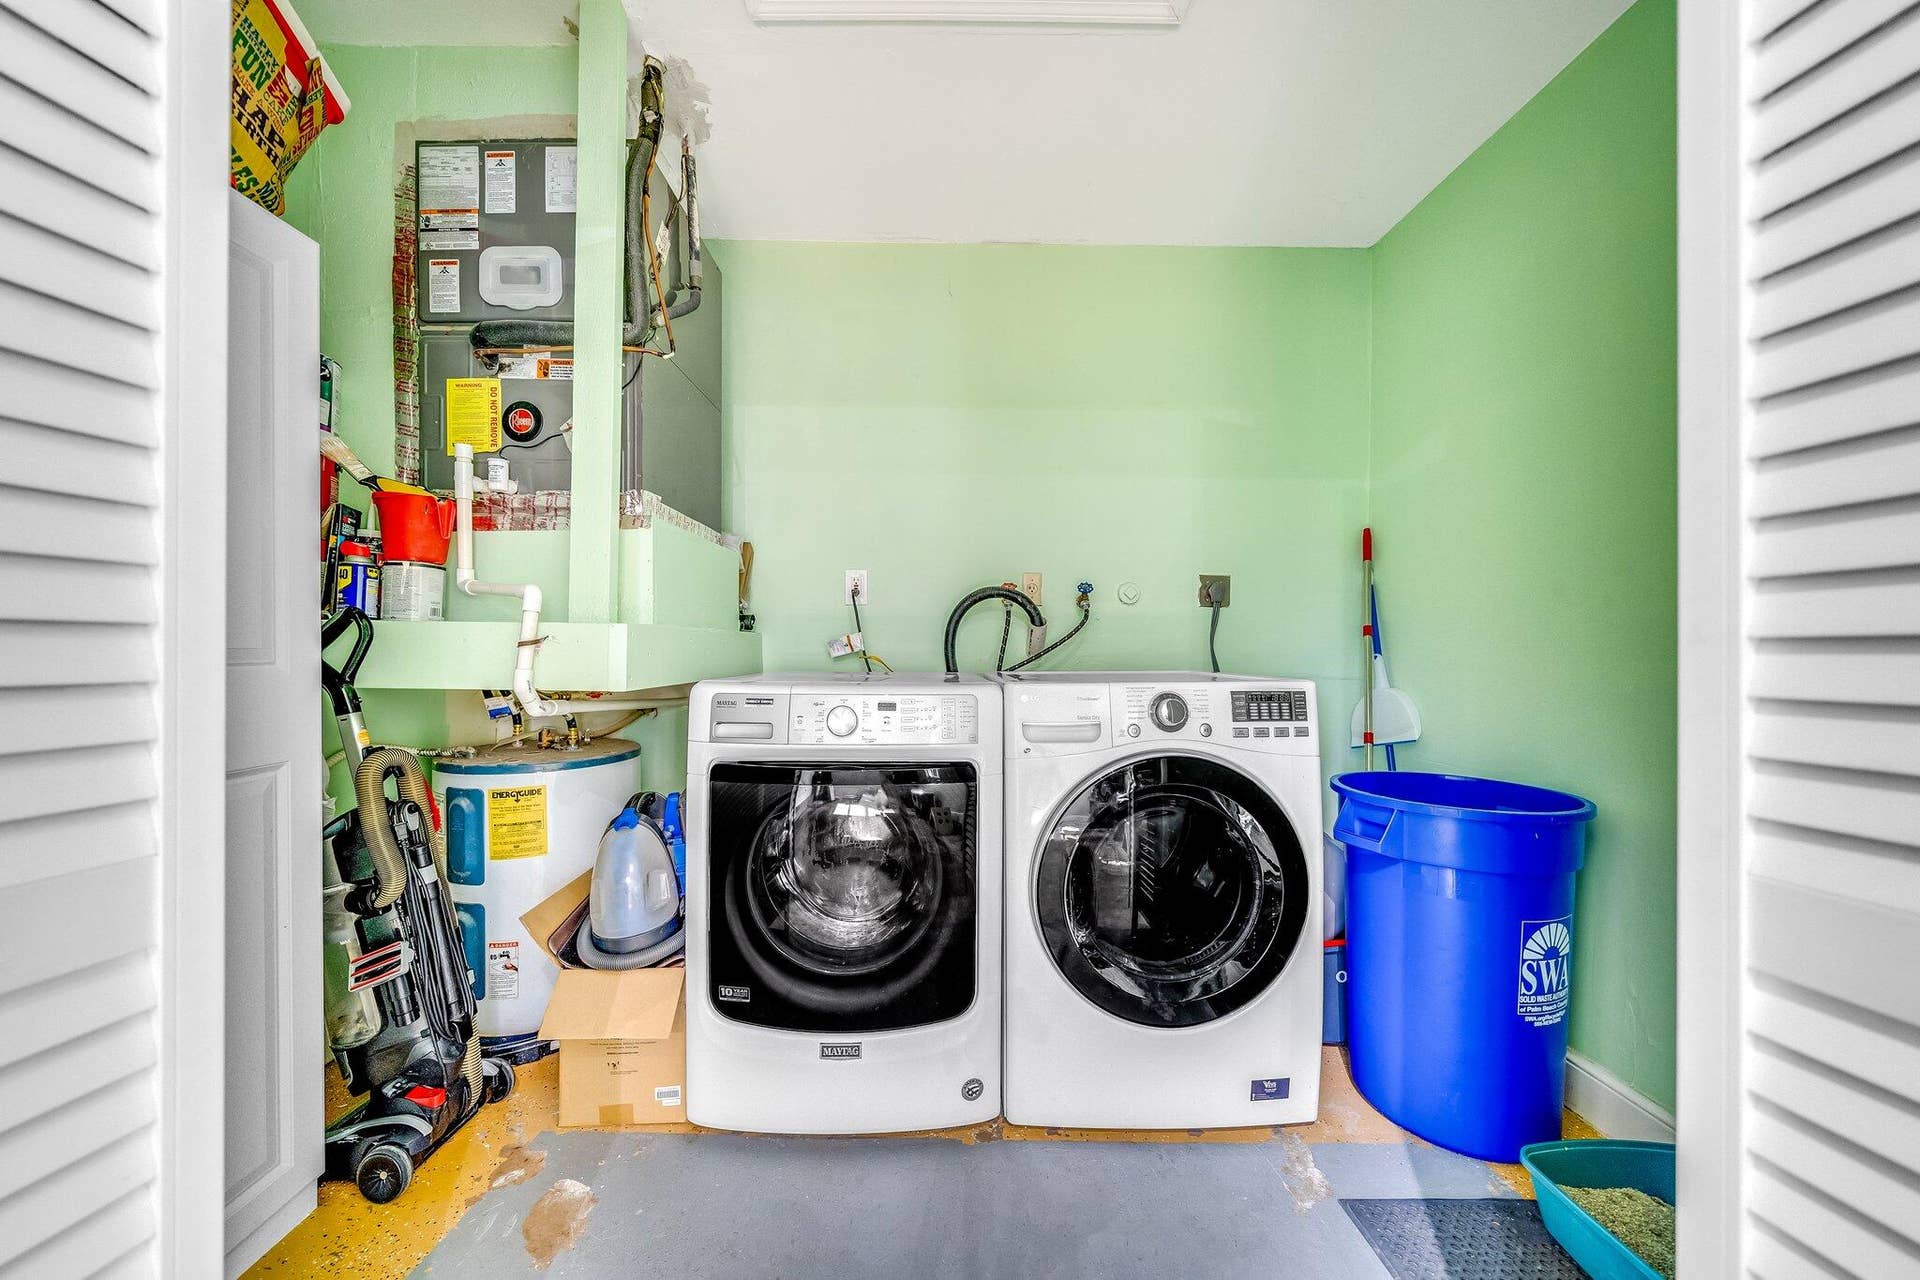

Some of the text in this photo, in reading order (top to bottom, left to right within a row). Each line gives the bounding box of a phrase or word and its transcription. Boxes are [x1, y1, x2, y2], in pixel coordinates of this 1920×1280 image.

[240, 15, 280, 69] HAPPY
[232, 28, 274, 91] FUN
[490, 387, 497, 398] DO
[490, 415, 498, 448] REMOVE
[1521, 956, 1568, 995] SWA
[720, 987, 732, 996] 10
[1519, 995, 1536, 1003] SOLID
[1537, 993, 1553, 1002] WASTE
[1542, 1003, 1556, 1011] Beach
[822, 1046, 859, 1056] MAYTAG
